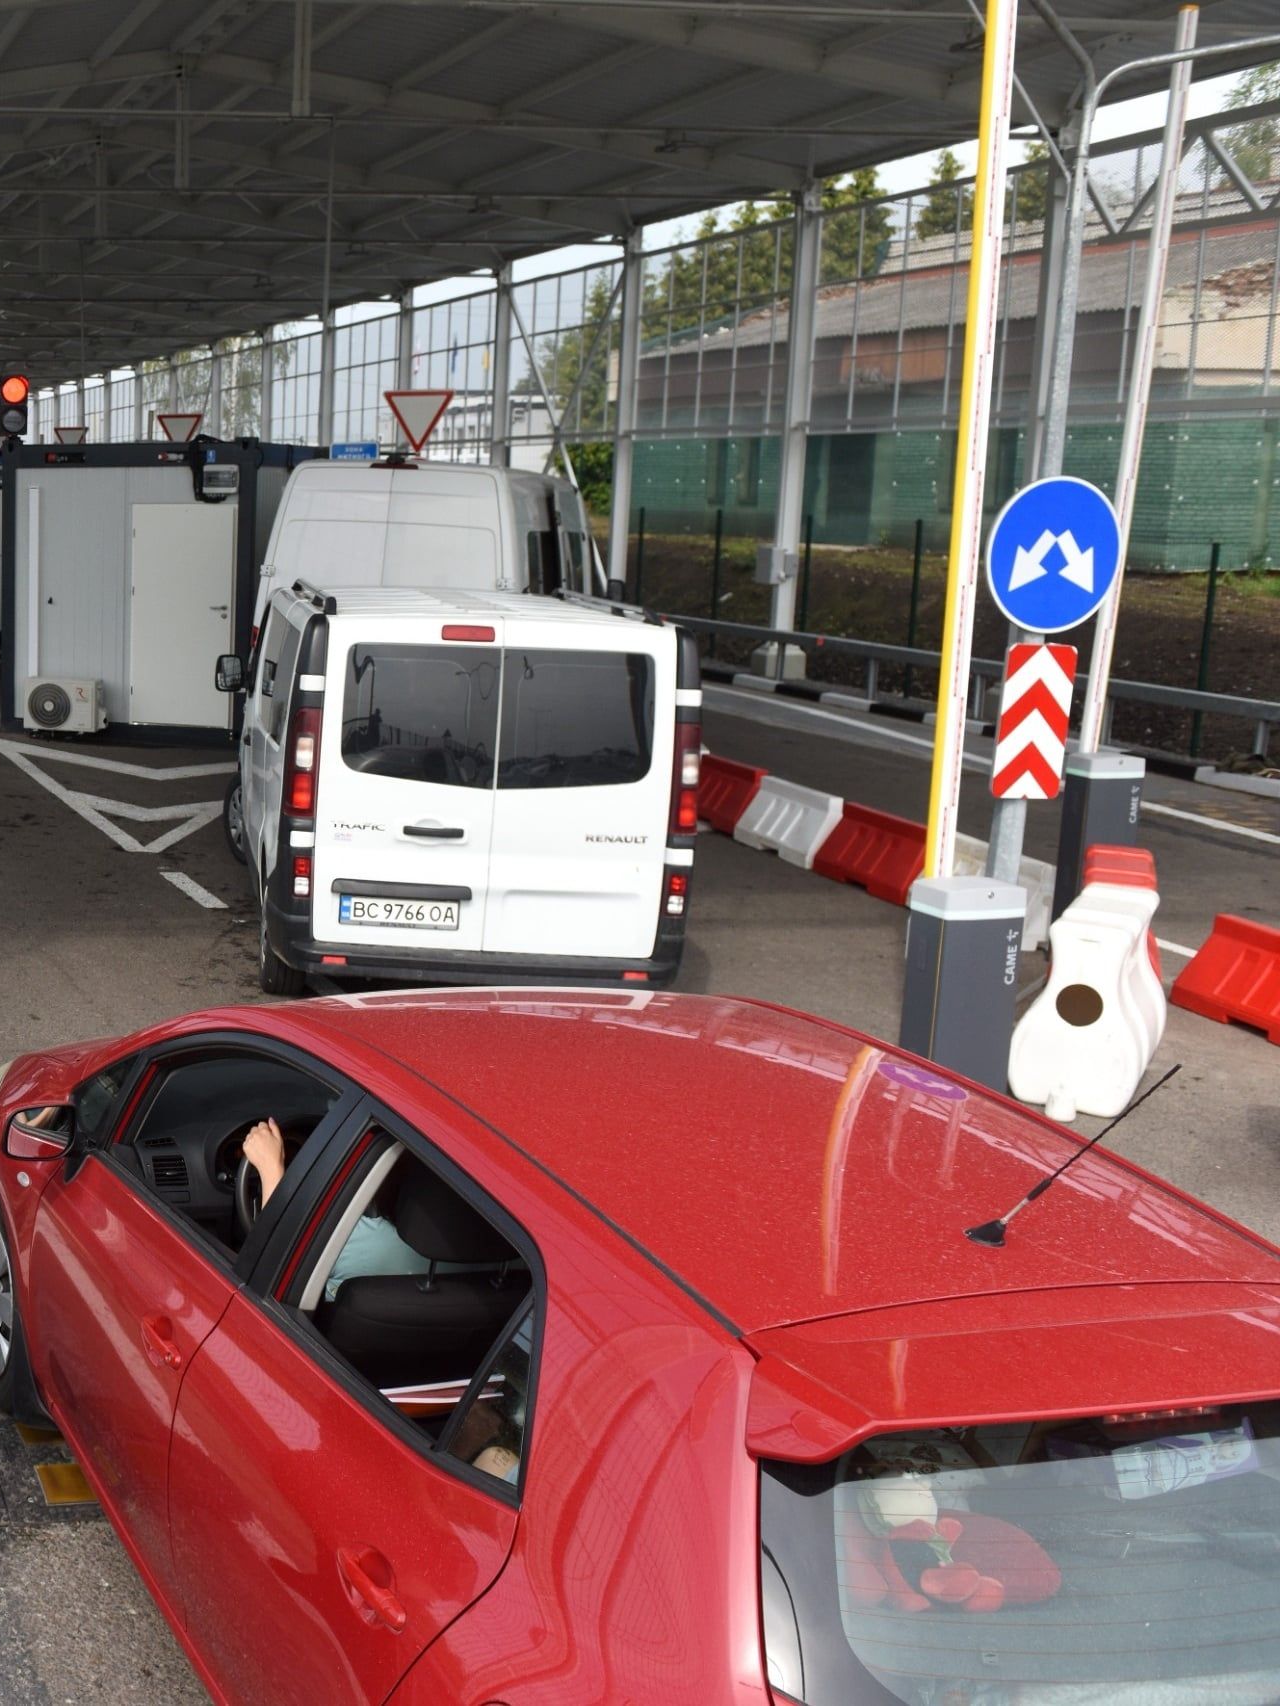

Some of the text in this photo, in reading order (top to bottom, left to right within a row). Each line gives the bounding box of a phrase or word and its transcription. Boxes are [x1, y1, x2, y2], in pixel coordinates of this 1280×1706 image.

[1128, 795, 1140, 824] CAME
[331, 820, 385, 831] TRAFIC
[584, 833, 649, 845] RENAULT
[353, 901, 455, 923] BC 9766 OA
[1003, 944, 1018, 985] CAME
